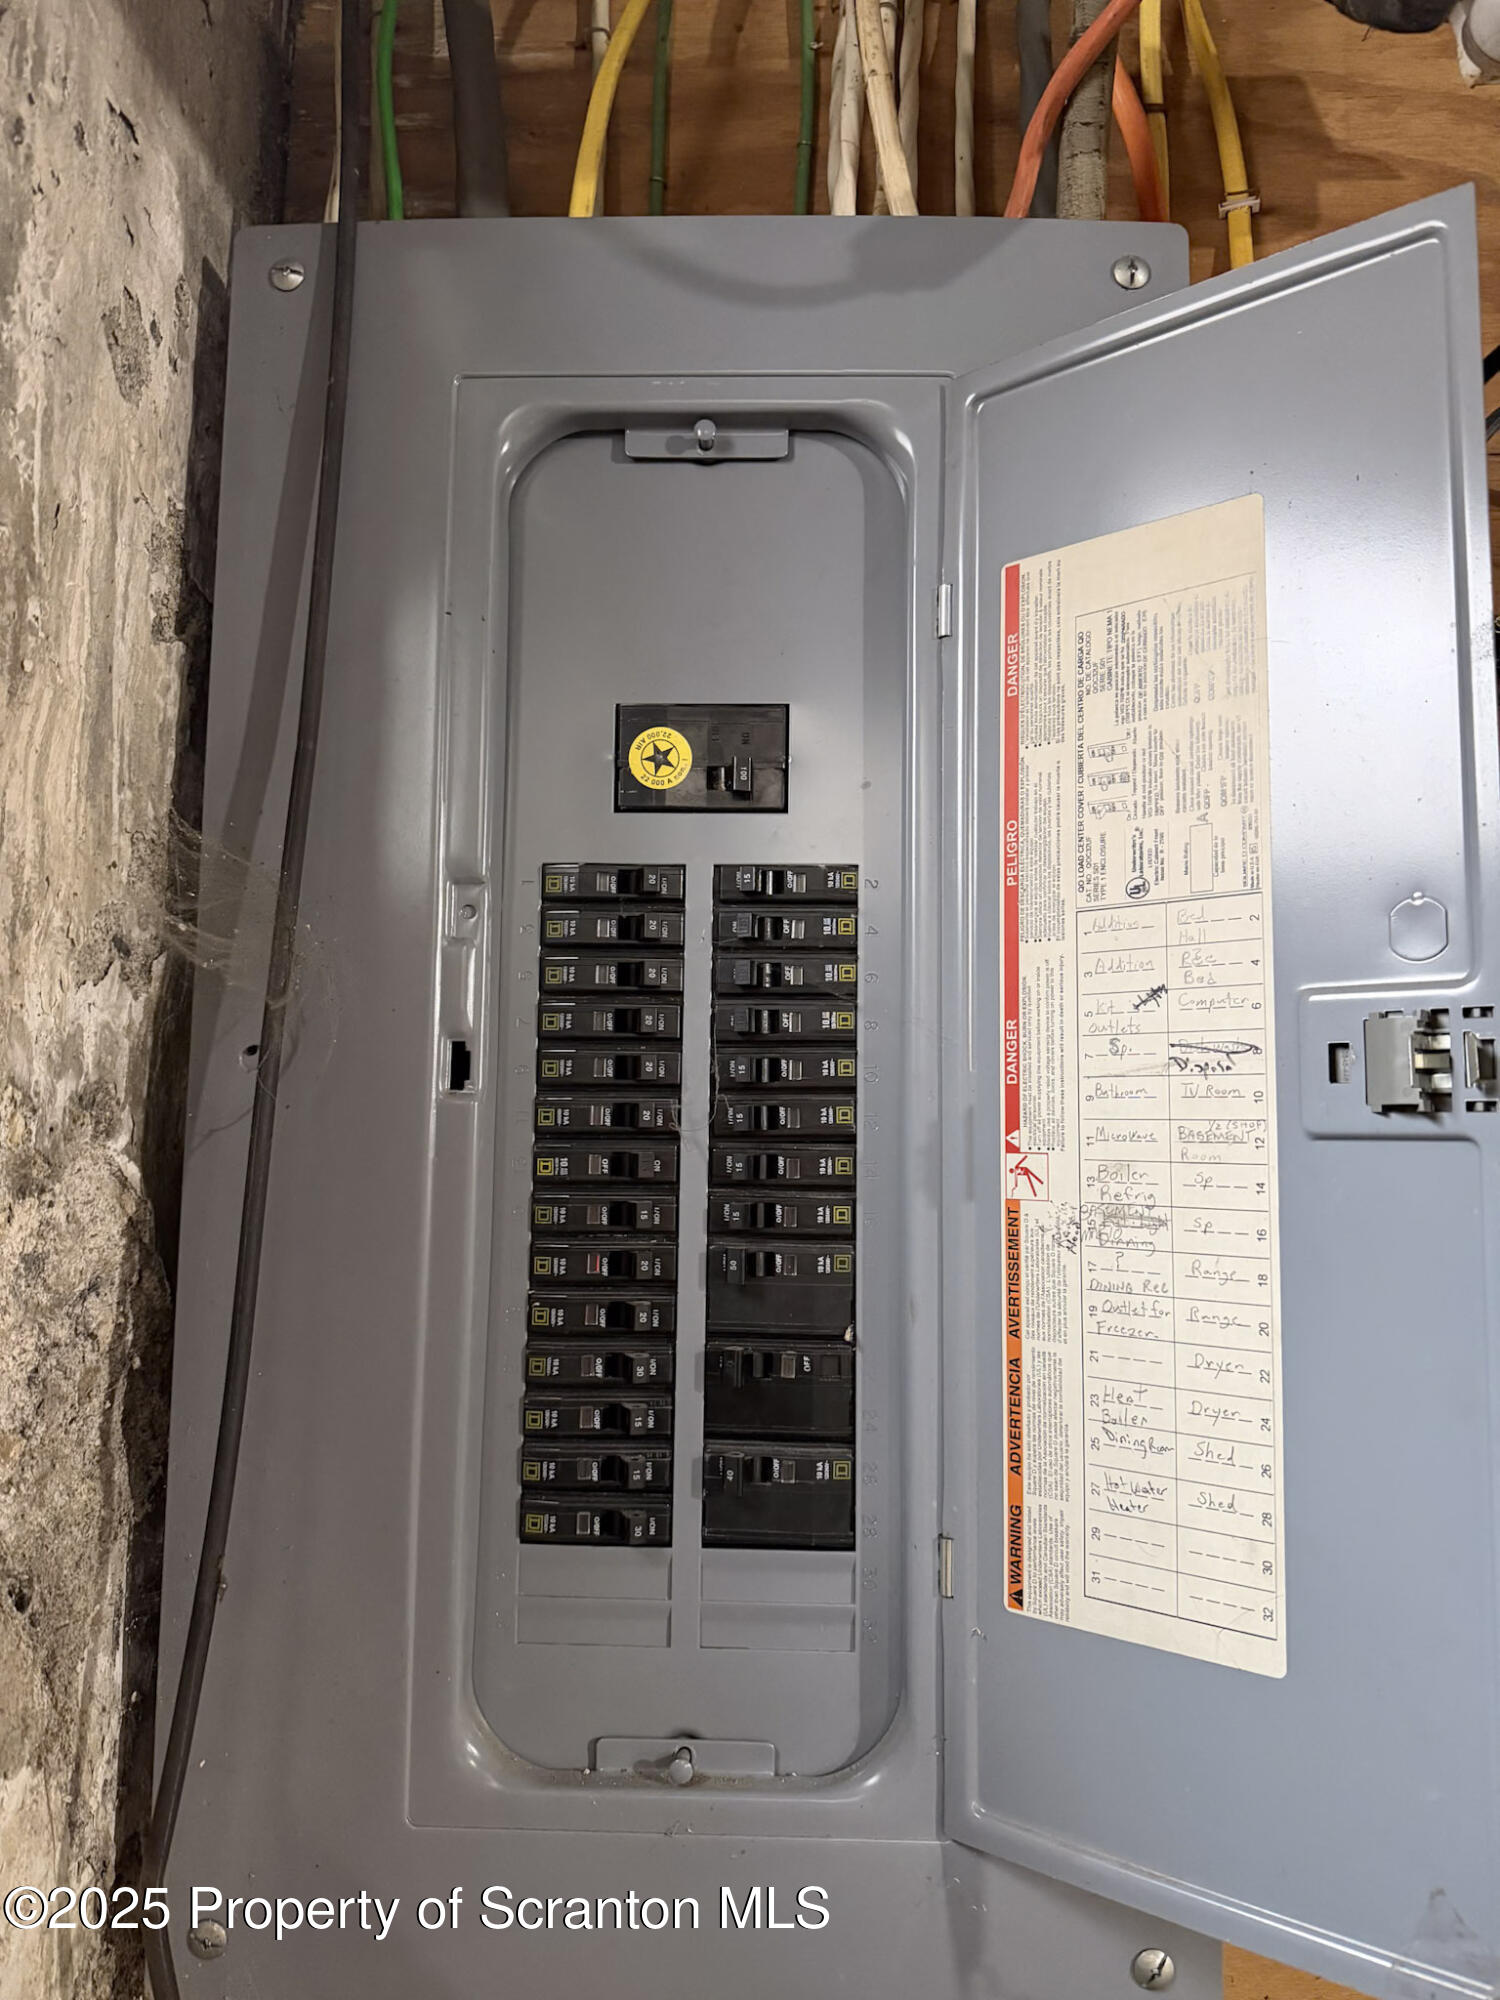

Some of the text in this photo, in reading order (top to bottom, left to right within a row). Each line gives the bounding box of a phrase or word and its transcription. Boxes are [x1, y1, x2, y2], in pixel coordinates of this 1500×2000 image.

[1077, 631, 1084, 645] QO
[1007, 632, 1019, 697] DANGER
[1077, 676, 1084, 688] DE
[1085, 671, 1092, 682] DE
[634, 737, 647, 751] AIR
[740, 766, 748, 781] 100
[1077, 791, 1085, 819] COVER
[1077, 821, 1085, 853] CENTER
[1006, 819, 1018, 886] PELIGRO
[1077, 854, 1085, 878] LOAD
[648, 874, 657, 885] 20
[743, 873, 751, 883] 15
[864, 879, 879, 889] 2
[1077, 879, 1085, 893] QO
[1250, 914, 1260, 922] 2
[648, 919, 657, 931] 20
[864, 925, 878, 936] 4
[1251, 958, 1260, 966] 4
[648, 968, 657, 979] 20
[864, 970, 879, 984] 6
[1252, 1002, 1262, 1010] 6
[645, 1014, 653, 1026] 20
[864, 1020, 879, 1031] 8
[1006, 1019, 1018, 1085] DANGER
[645, 1061, 653, 1072] 20
[738, 1065, 746, 1074] 15
[864, 1065, 879, 1082] 10
[1181, 1082, 1241, 1097] TV Room
[1255, 1090, 1264, 1103] 10
[642, 1110, 651, 1121] 20
[736, 1113, 744, 1123] 15
[1086, 1136, 1095, 1147] 11
[1255, 1136, 1265, 1149] 12
[601, 1158, 609, 1174] OFF
[653, 1160, 661, 1172] ON
[736, 1162, 744, 1172] 15
[1087, 1176, 1096, 1187] 13
[1256, 1182, 1266, 1195] 14
[640, 1209, 648, 1220] 15
[733, 1211, 741, 1221] 15
[1257, 1228, 1267, 1242] 16
[640, 1260, 649, 1271] 20
[729, 1260, 737, 1271] 50
[1088, 1261, 1097, 1273] 17
[1007, 1206, 1020, 1339] AVERTISSEMENT
[1258, 1273, 1268, 1287] 18
[1089, 1304, 1098, 1317] 19
[639, 1312, 648, 1323] 20
[1259, 1322, 1270, 1337] 20
[1090, 1350, 1100, 1362] 21
[803, 1355, 811, 1372] OFF
[636, 1366, 645, 1377] 30
[1260, 1369, 1271, 1384] 22
[1091, 1393, 1101, 1408] 23
[1009, 1357, 1022, 1476] ADVERTENCIA
[1191, 1401, 1242, 1426] Dryer
[634, 1416, 643, 1427] 15
[1261, 1418, 1271, 1433] 24
[1091, 1437, 1101, 1451] 25
[1194, 1441, 1236, 1466] Shed
[632, 1469, 641, 1480] 15
[727, 1470, 735, 1481] 40
[1261, 1464, 1272, 1479] 26
[1091, 1482, 1101, 1496] 27
[1197, 1492, 1237, 1514] Shed
[1262, 1511, 1273, 1527] 28
[634, 1525, 643, 1537] 30
[1091, 1526, 1101, 1541] 29
[1009, 1504, 1022, 1585] WARNING
[1262, 1560, 1273, 1575] 30
[1092, 1570, 1102, 1584] 31
[1262, 1606, 1274, 1621] 32
